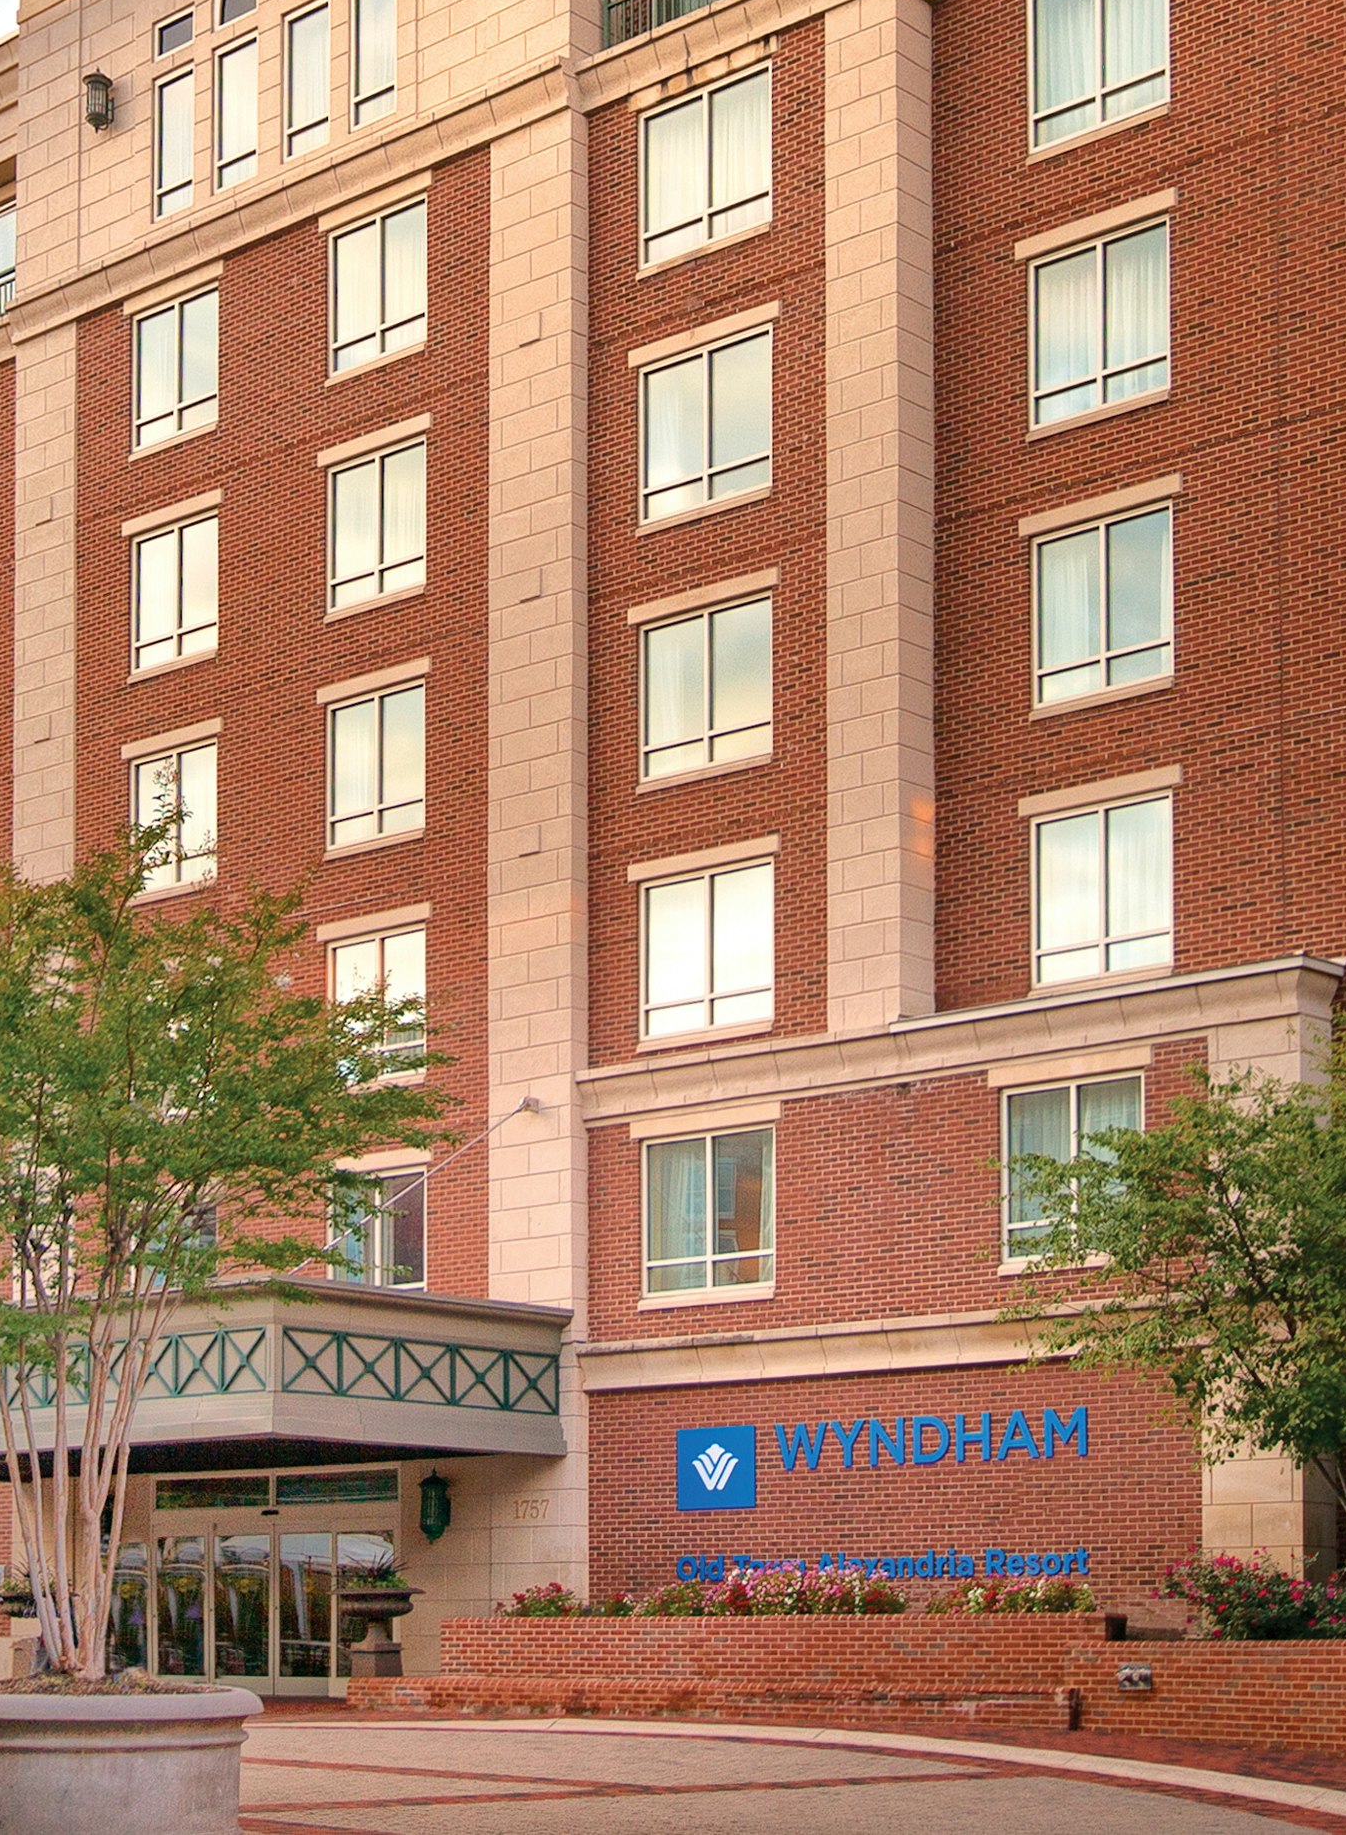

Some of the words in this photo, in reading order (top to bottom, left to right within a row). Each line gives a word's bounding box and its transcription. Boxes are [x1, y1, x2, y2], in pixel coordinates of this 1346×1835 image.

[774, 1406, 1089, 1472] WYNDHAM
[513, 1499, 550, 1520] 1757
[675, 1554, 725, 1582] Old
[984, 1547, 1090, 1577] Resort
